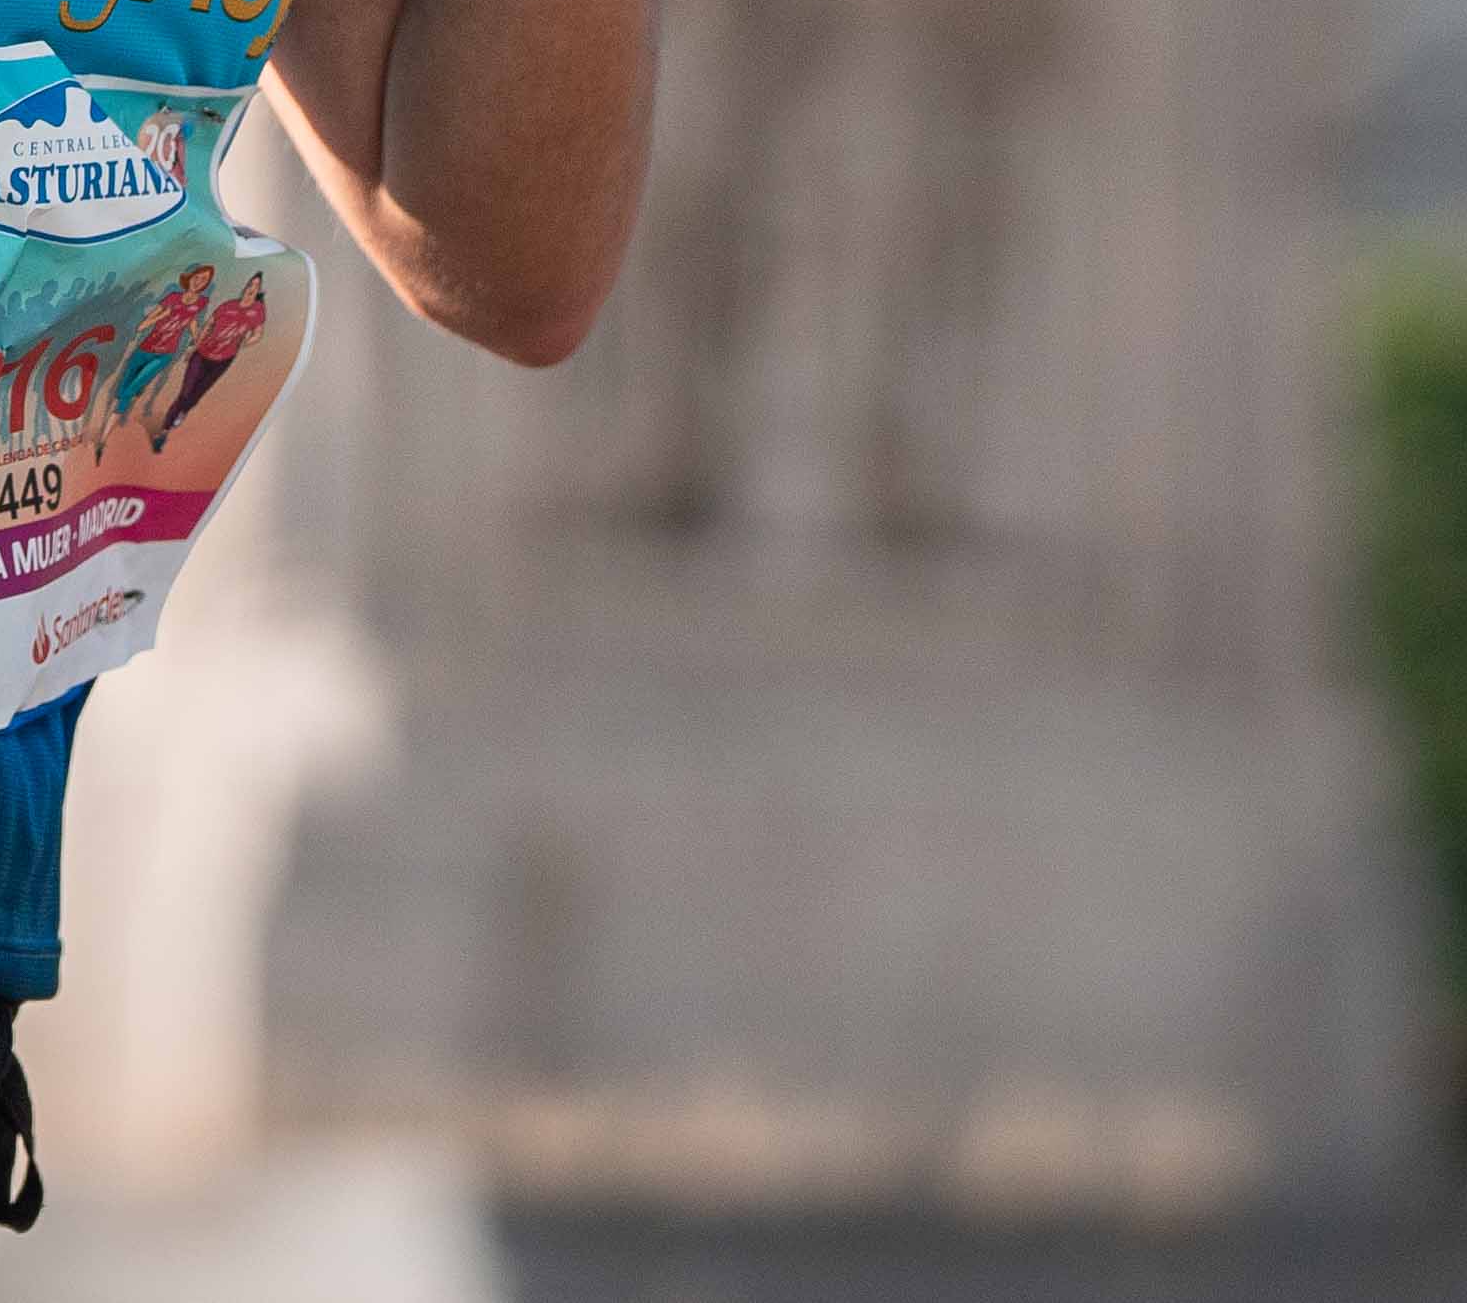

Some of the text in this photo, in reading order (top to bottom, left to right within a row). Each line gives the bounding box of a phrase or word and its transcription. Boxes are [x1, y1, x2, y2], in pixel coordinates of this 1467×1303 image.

[13, 135, 95, 158] CENTRAL
[13, 524, 71, 577] MUJER
[78, 496, 146, 548] MADRID
